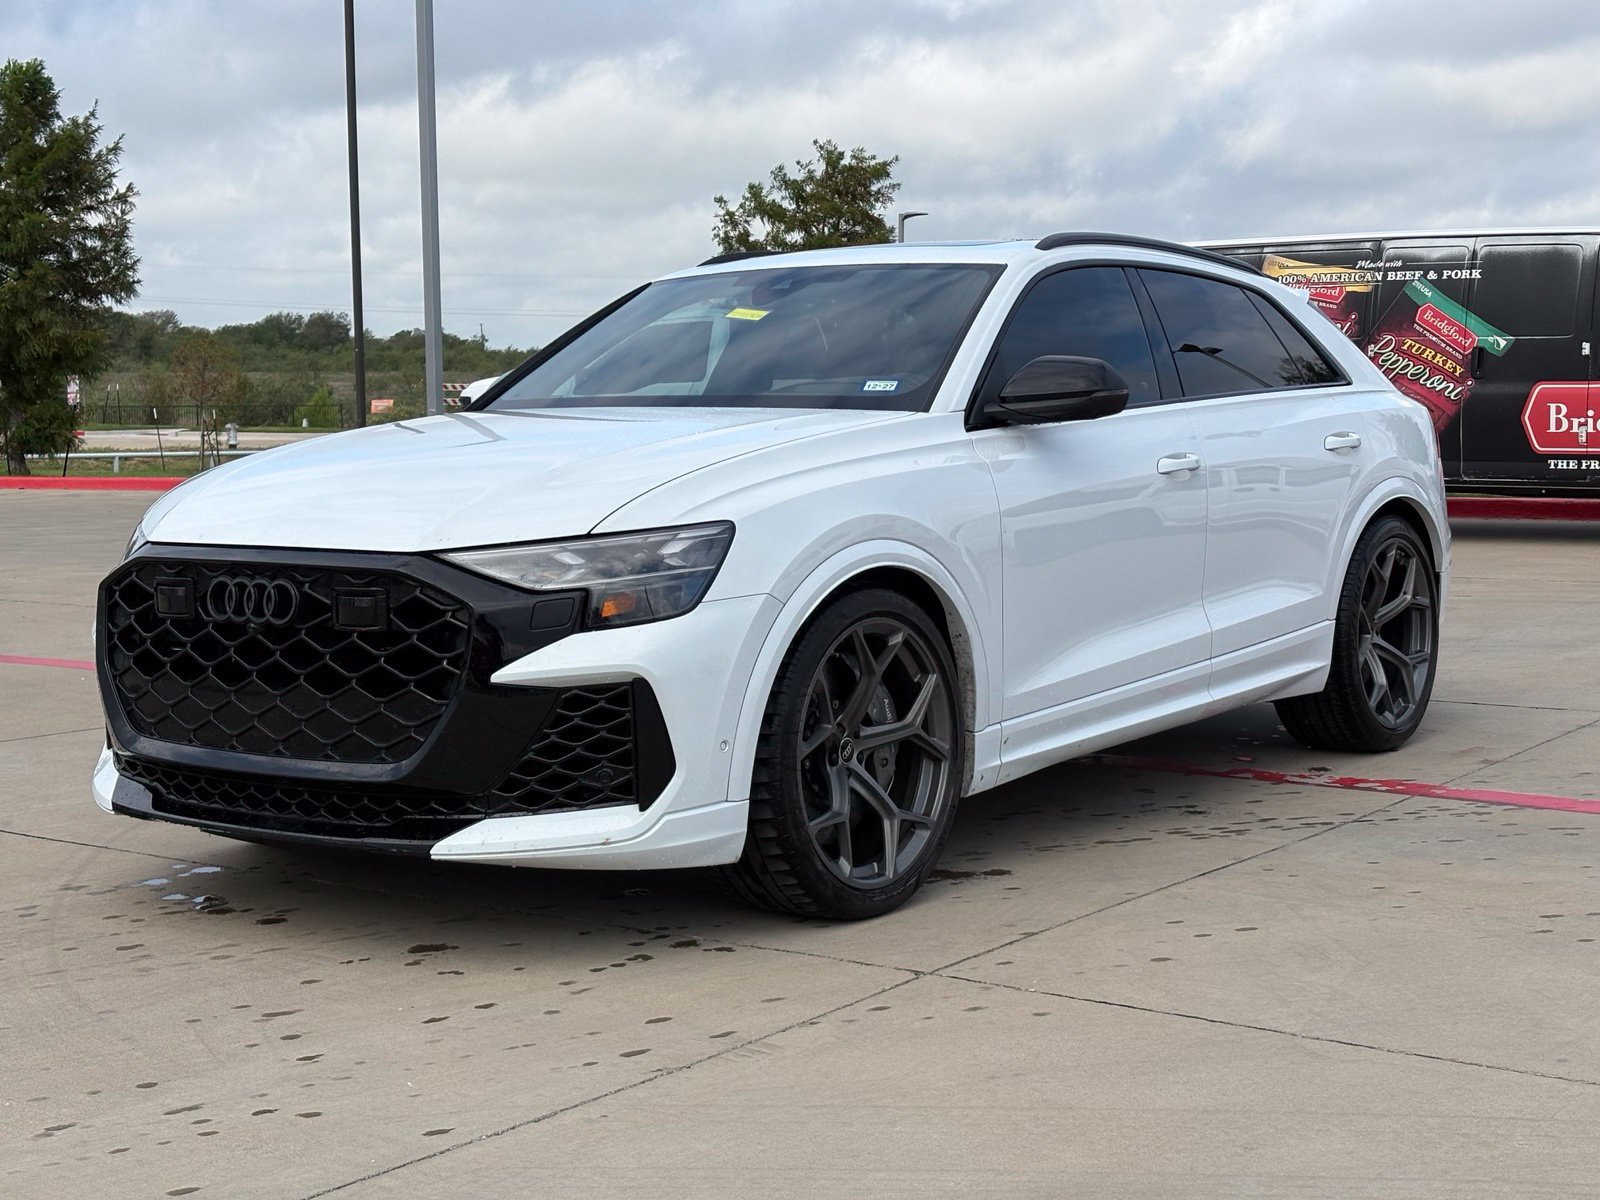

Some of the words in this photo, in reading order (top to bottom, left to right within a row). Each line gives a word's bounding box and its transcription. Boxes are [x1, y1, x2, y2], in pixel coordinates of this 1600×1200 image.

[1278, 274, 1307, 284] 100%
[1310, 271, 1383, 283] AMERICAN
[1387, 270, 1423, 280] BEEF
[1427, 270, 1438, 280] &
[1442, 269, 1482, 279] PORK
[1355, 260, 1384, 269] Made
[1385, 260, 1402, 268] with
[1420, 285, 1433, 298] USA
[1413, 323, 1424, 332] THE
[1423, 330, 1447, 348] PREMIUM
[1445, 346, 1463, 360] BRAND
[1423, 309, 1472, 347] Bridgford
[1374, 334, 1473, 400] Pepperoni
[1401, 339, 1465, 377] TURKEY
[1546, 403, 1600, 433] Bri
[1548, 460, 1578, 469] THE
